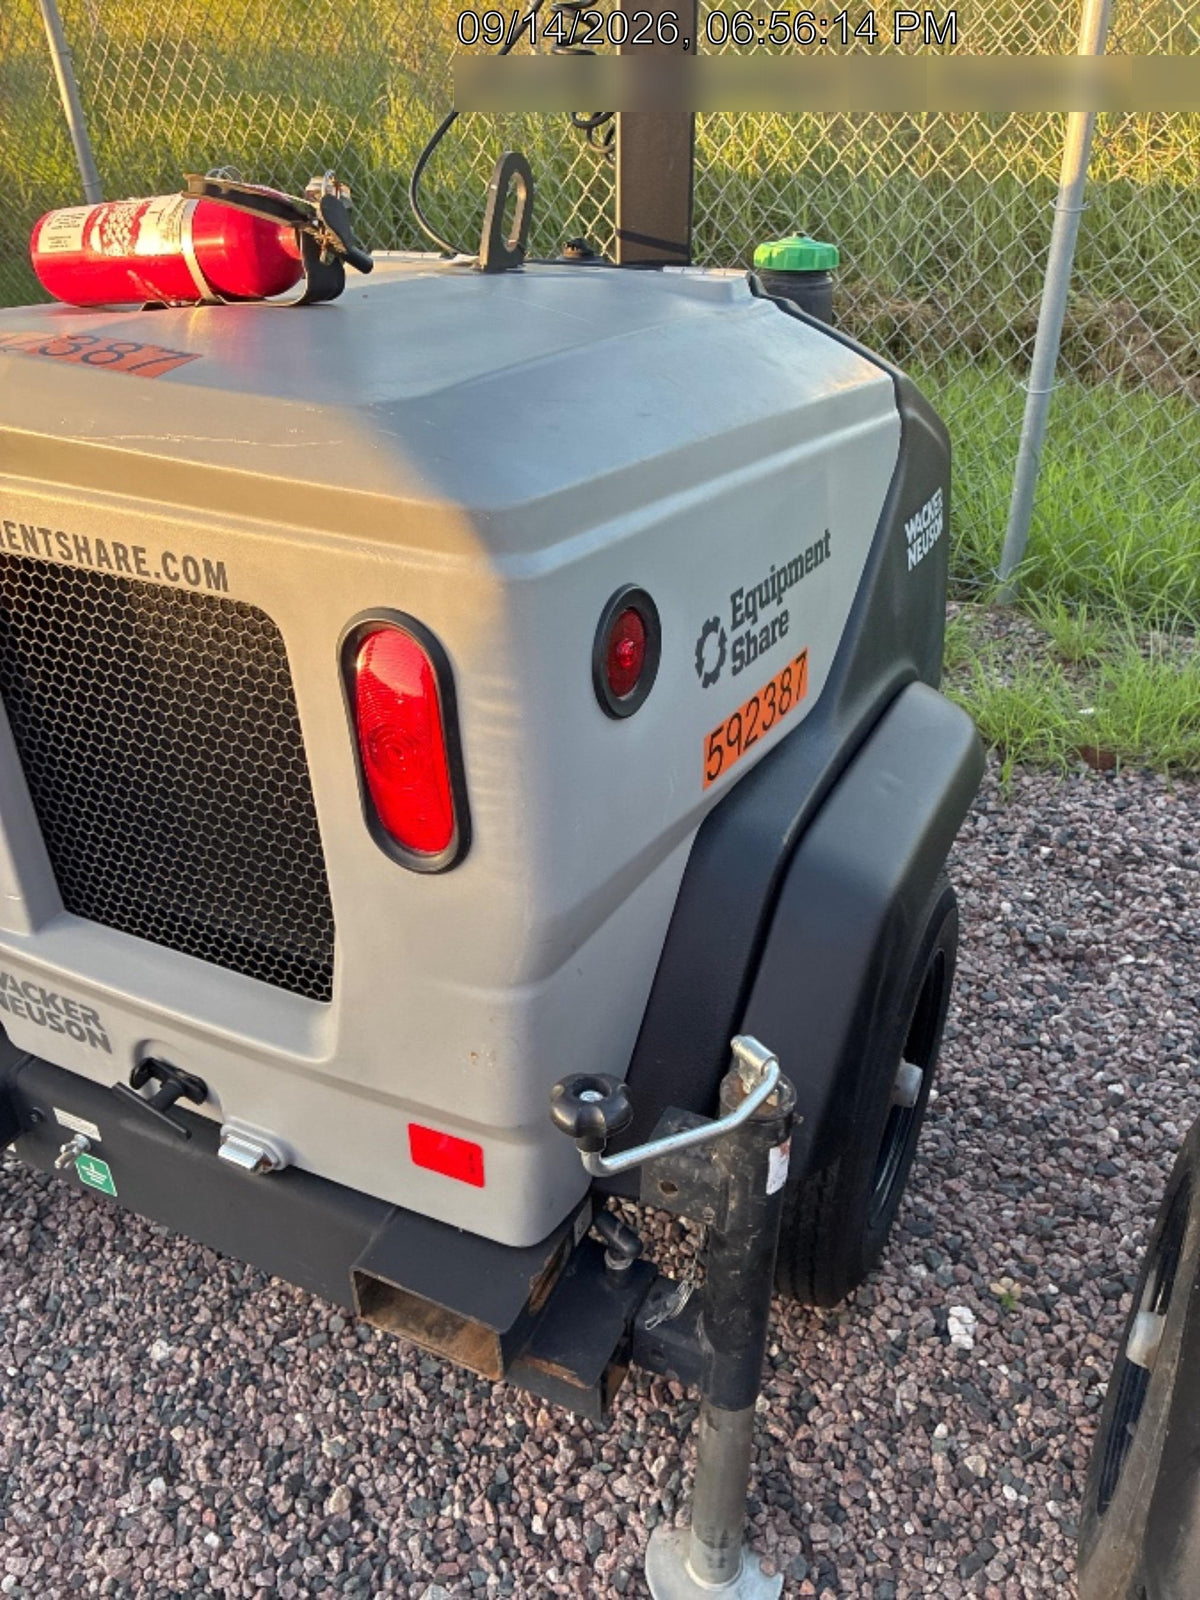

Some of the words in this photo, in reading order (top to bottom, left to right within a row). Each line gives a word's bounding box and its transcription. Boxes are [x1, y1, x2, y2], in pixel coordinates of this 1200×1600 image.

[0, 520, 229, 592] ENTSHARE.COM
[729, 528, 831, 632] Equipment
[731, 609, 790, 677] Share
[706, 650, 807, 781] 592387
